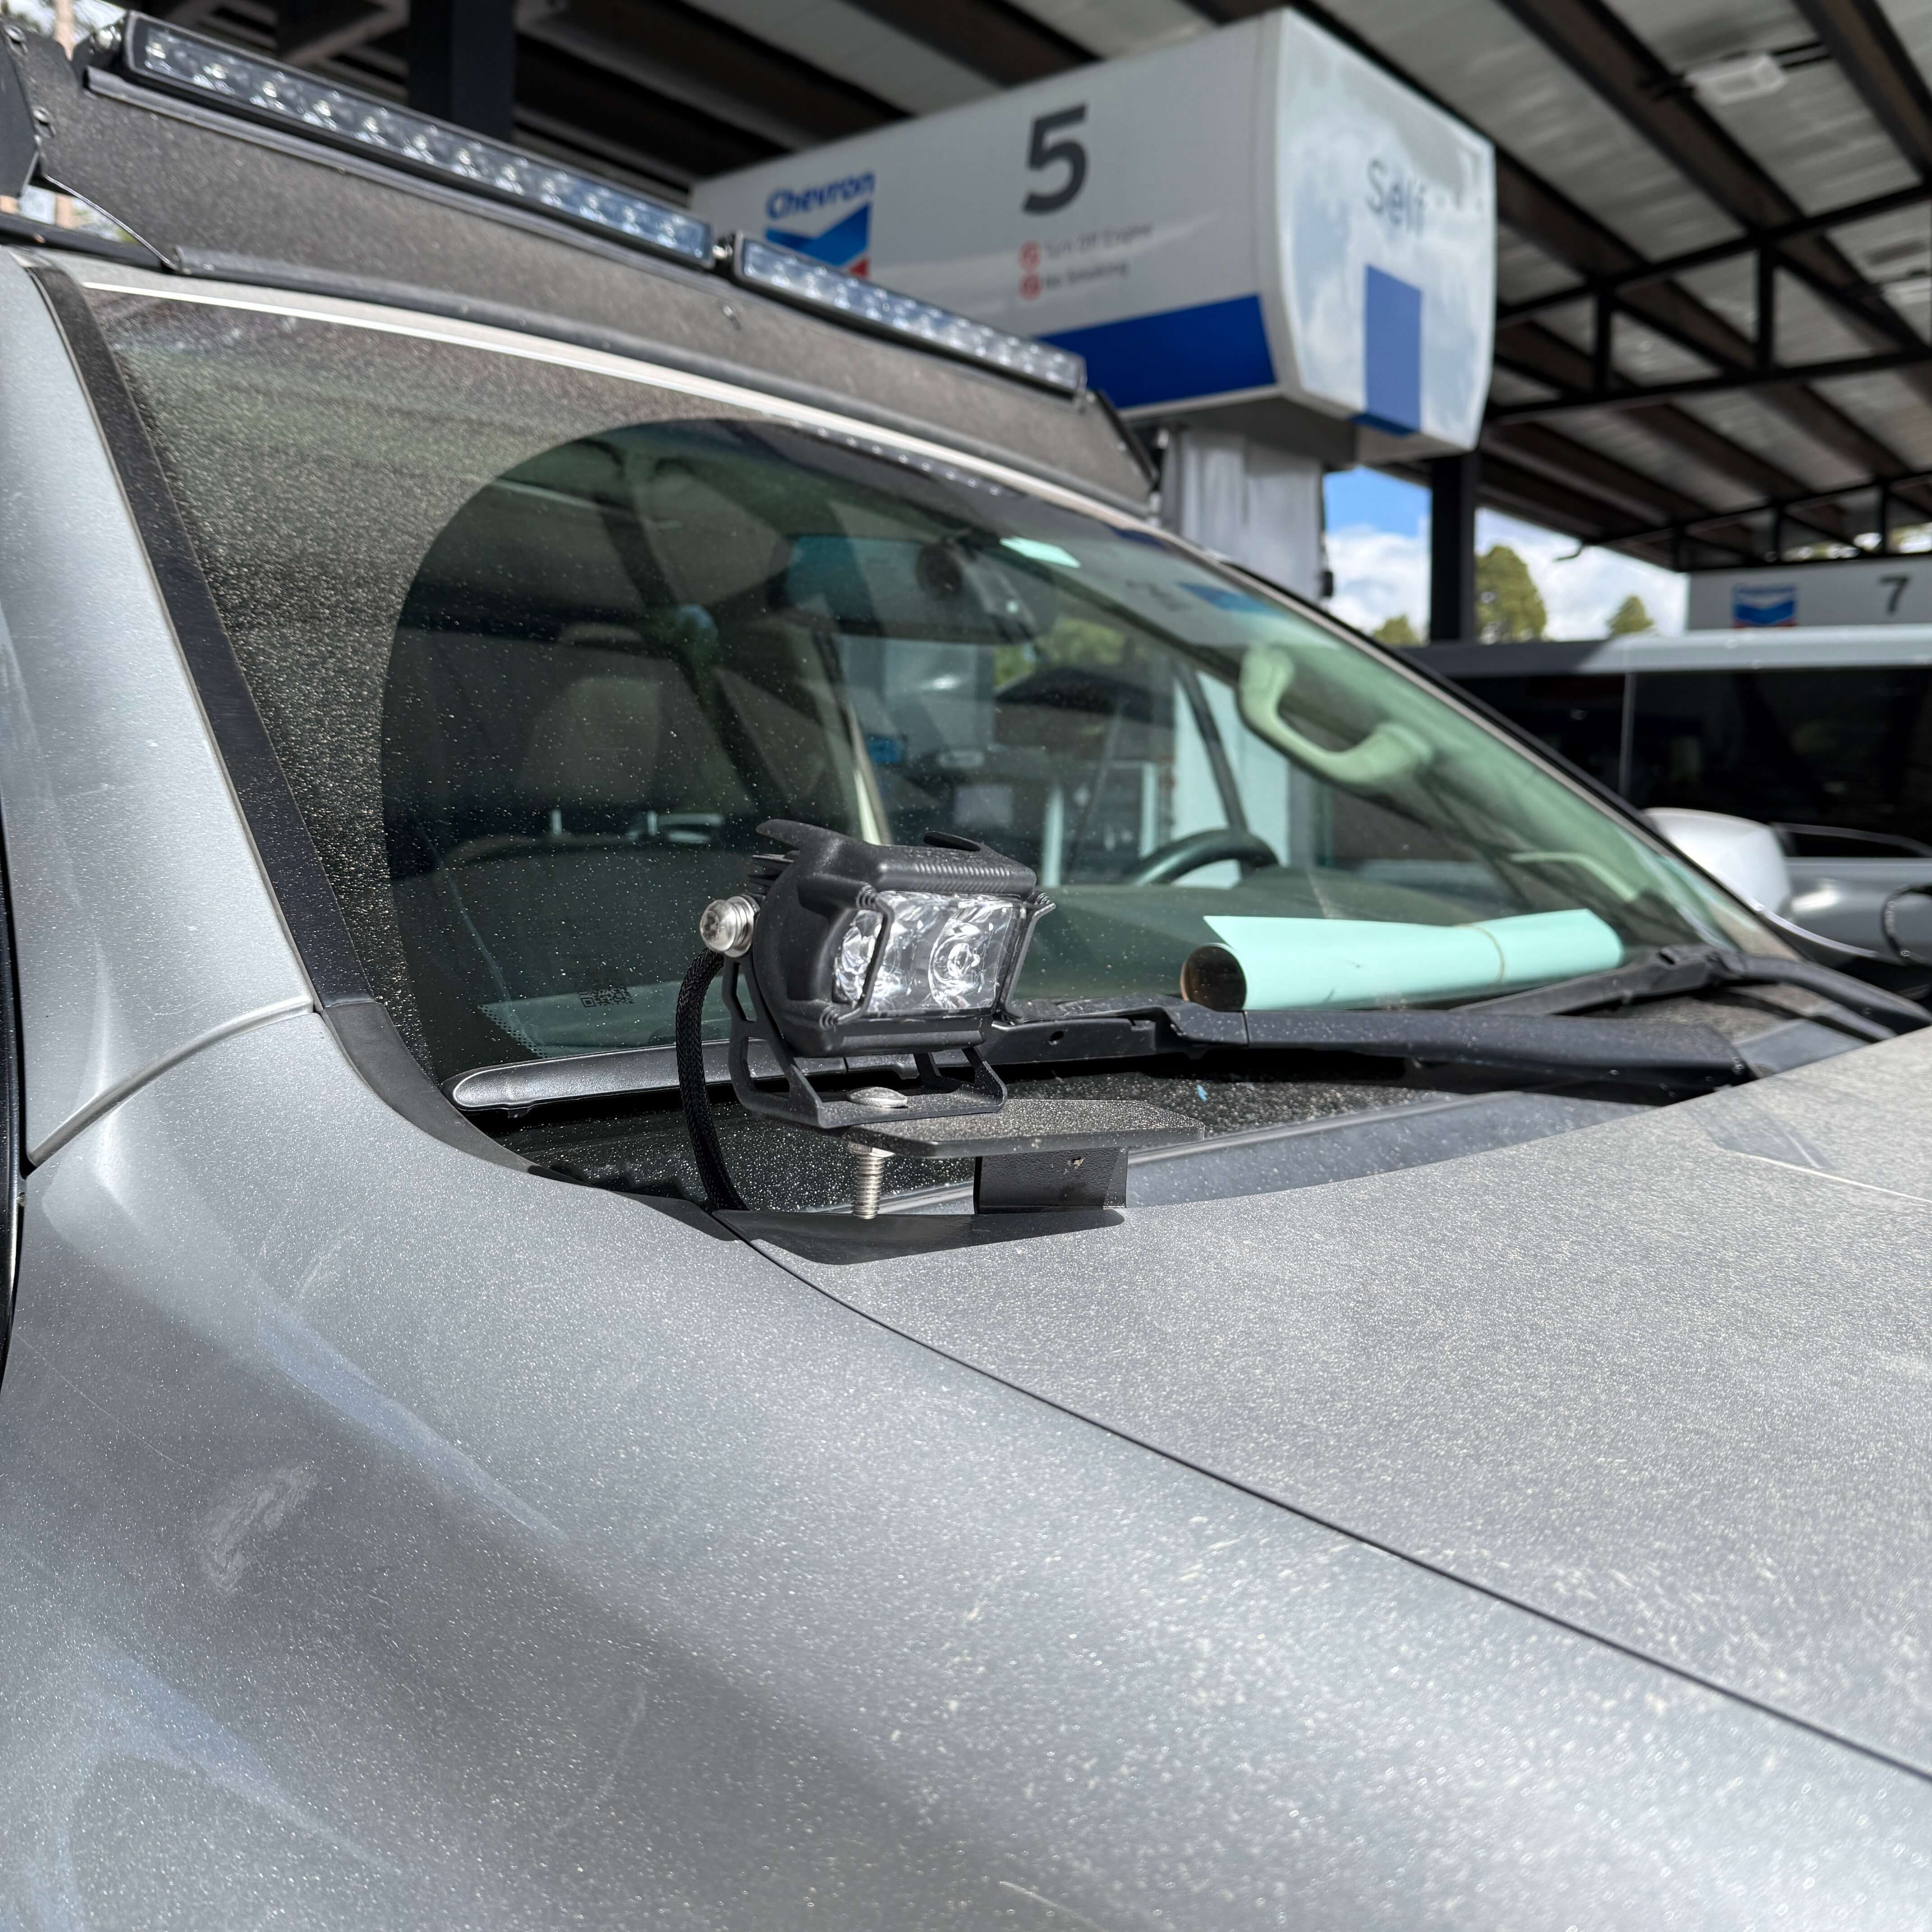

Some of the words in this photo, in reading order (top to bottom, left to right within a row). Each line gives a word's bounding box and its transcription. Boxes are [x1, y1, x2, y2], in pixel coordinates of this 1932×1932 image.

[1022, 104, 1088, 214] 5
[766, 172, 875, 220] Chevron
[1365, 159, 1425, 235] Self
[1880, 576, 1911, 614] 7
